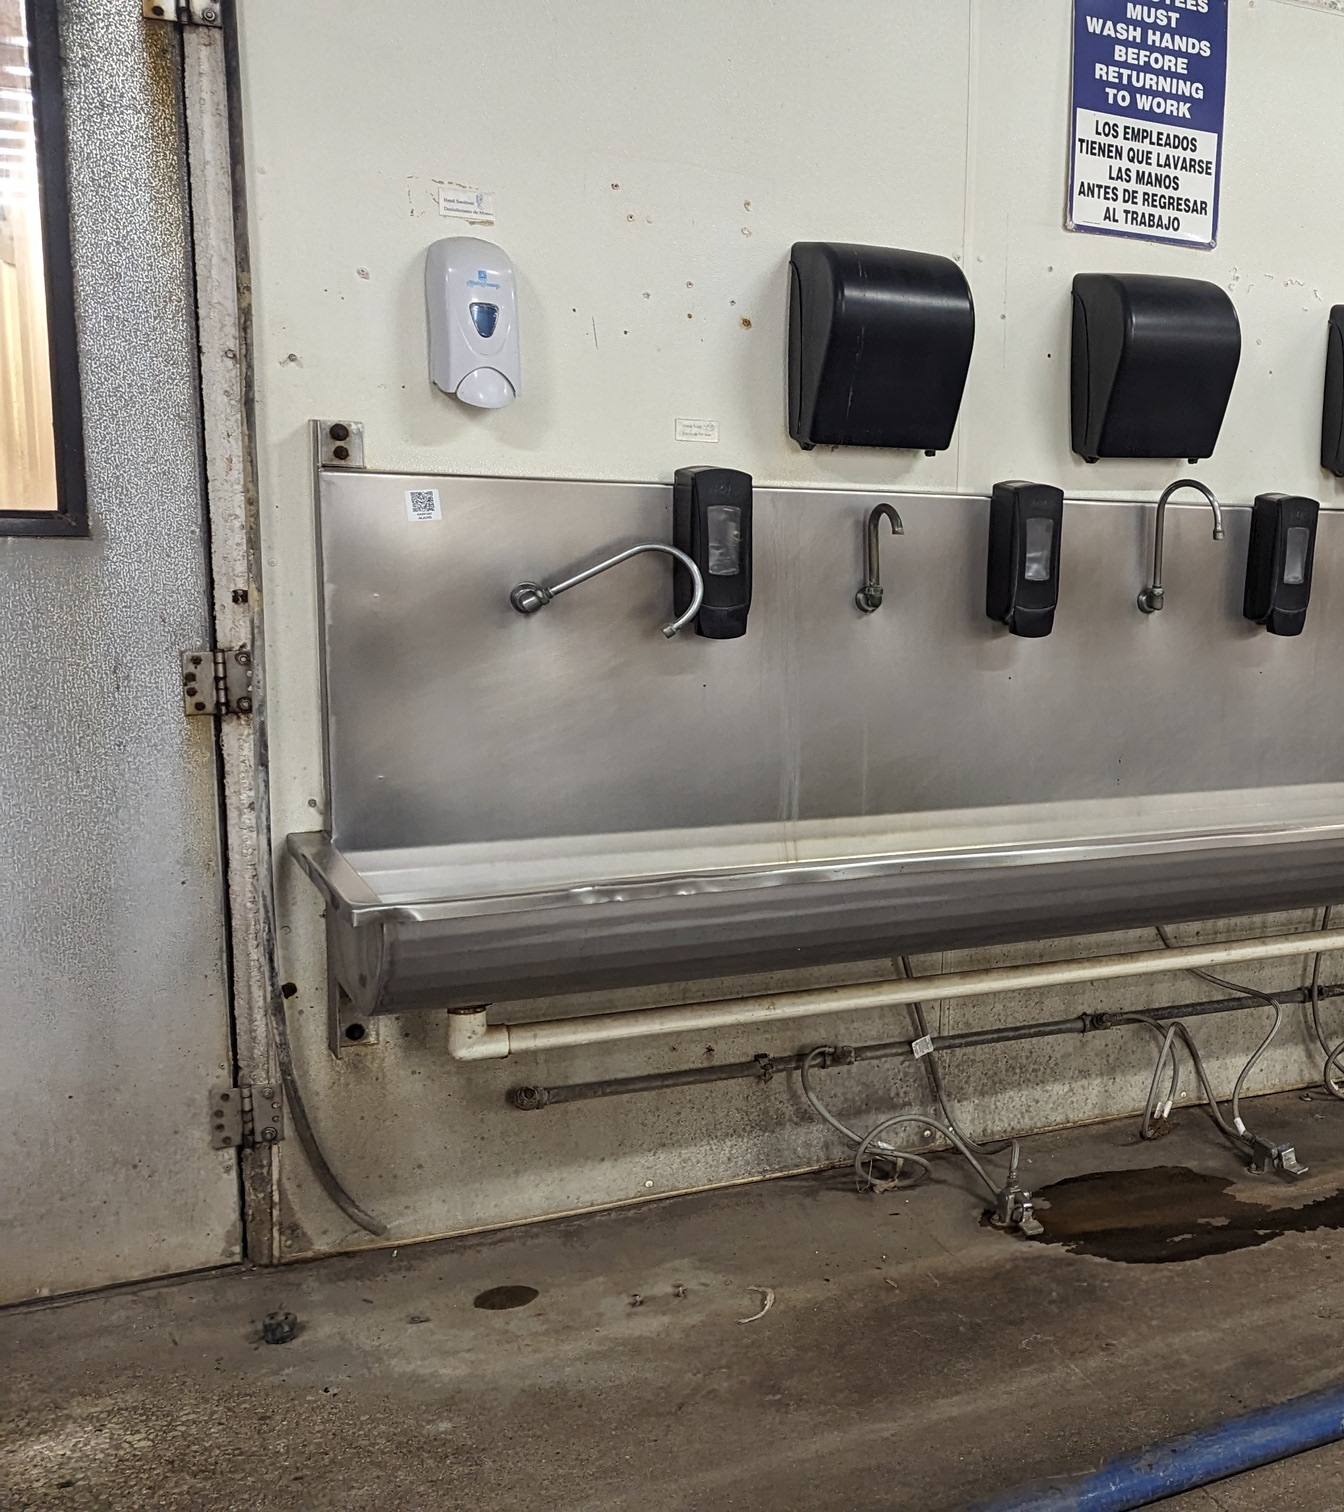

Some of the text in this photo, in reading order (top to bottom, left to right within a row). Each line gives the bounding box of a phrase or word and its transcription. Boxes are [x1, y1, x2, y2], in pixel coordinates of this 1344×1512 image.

[1126, 2, 1180, 28] MUST
[1086, 16, 1211, 57] WASH HANDS
[1114, 45, 1188, 74] BEFORE
[1094, 63, 1204, 99] RETURNING
[1105, 87, 1192, 119] TO WORK
[1095, 119, 1198, 153] LOS EMPLEADOS
[1078, 138, 1213, 176] TIENEN QUE LAVARSE
[1108, 165, 1180, 191] LAS MANOS
[1078, 181, 1208, 216] ANTES DE REGRESAR
[1103, 206, 1180, 232] AL TRABAJO
